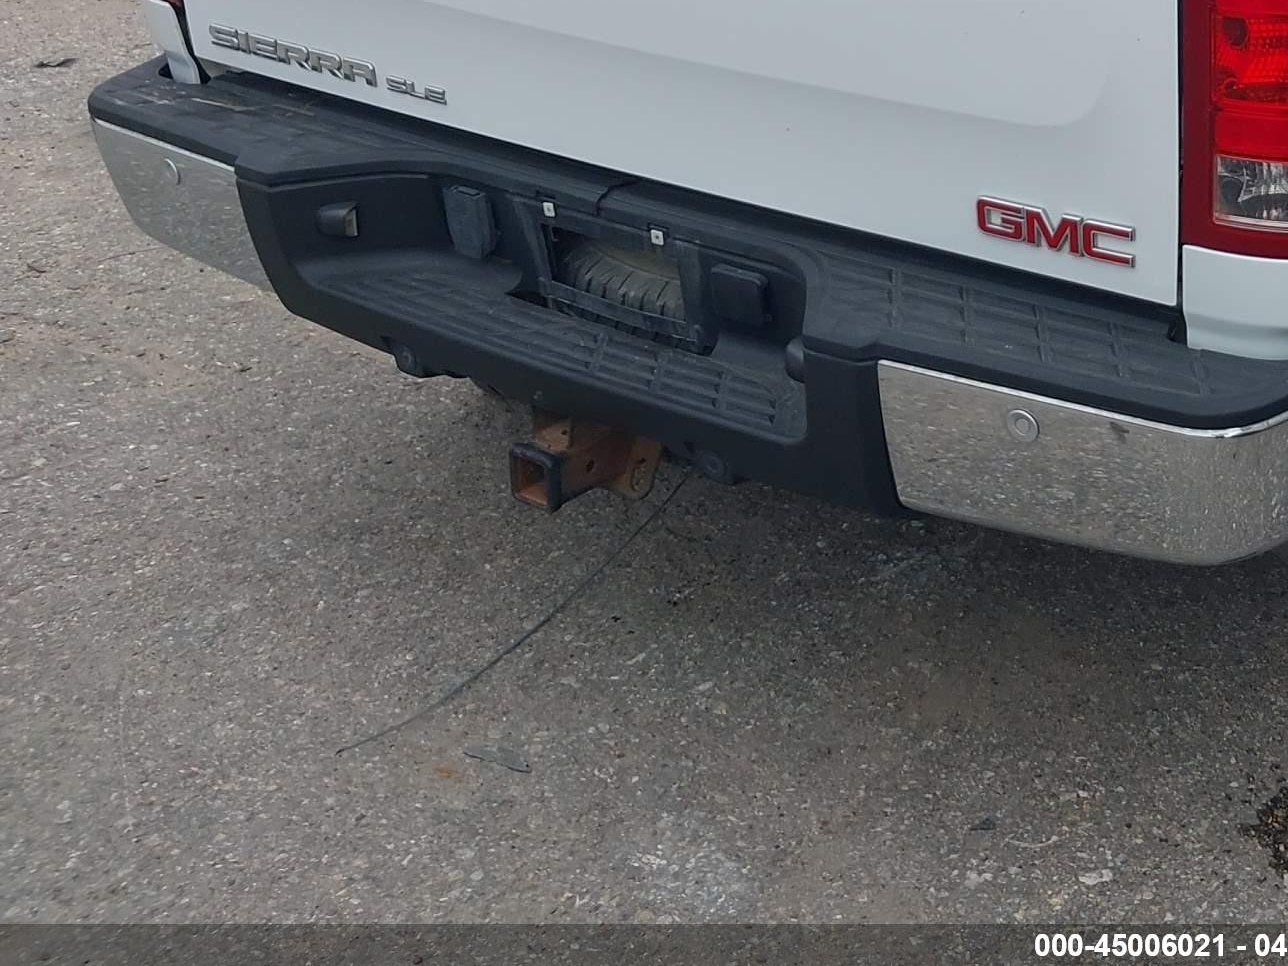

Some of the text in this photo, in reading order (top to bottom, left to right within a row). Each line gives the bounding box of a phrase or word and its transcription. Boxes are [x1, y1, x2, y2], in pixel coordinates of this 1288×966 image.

[208, 22, 448, 106] SIERRA SLE
[976, 194, 1136, 268] GMC
